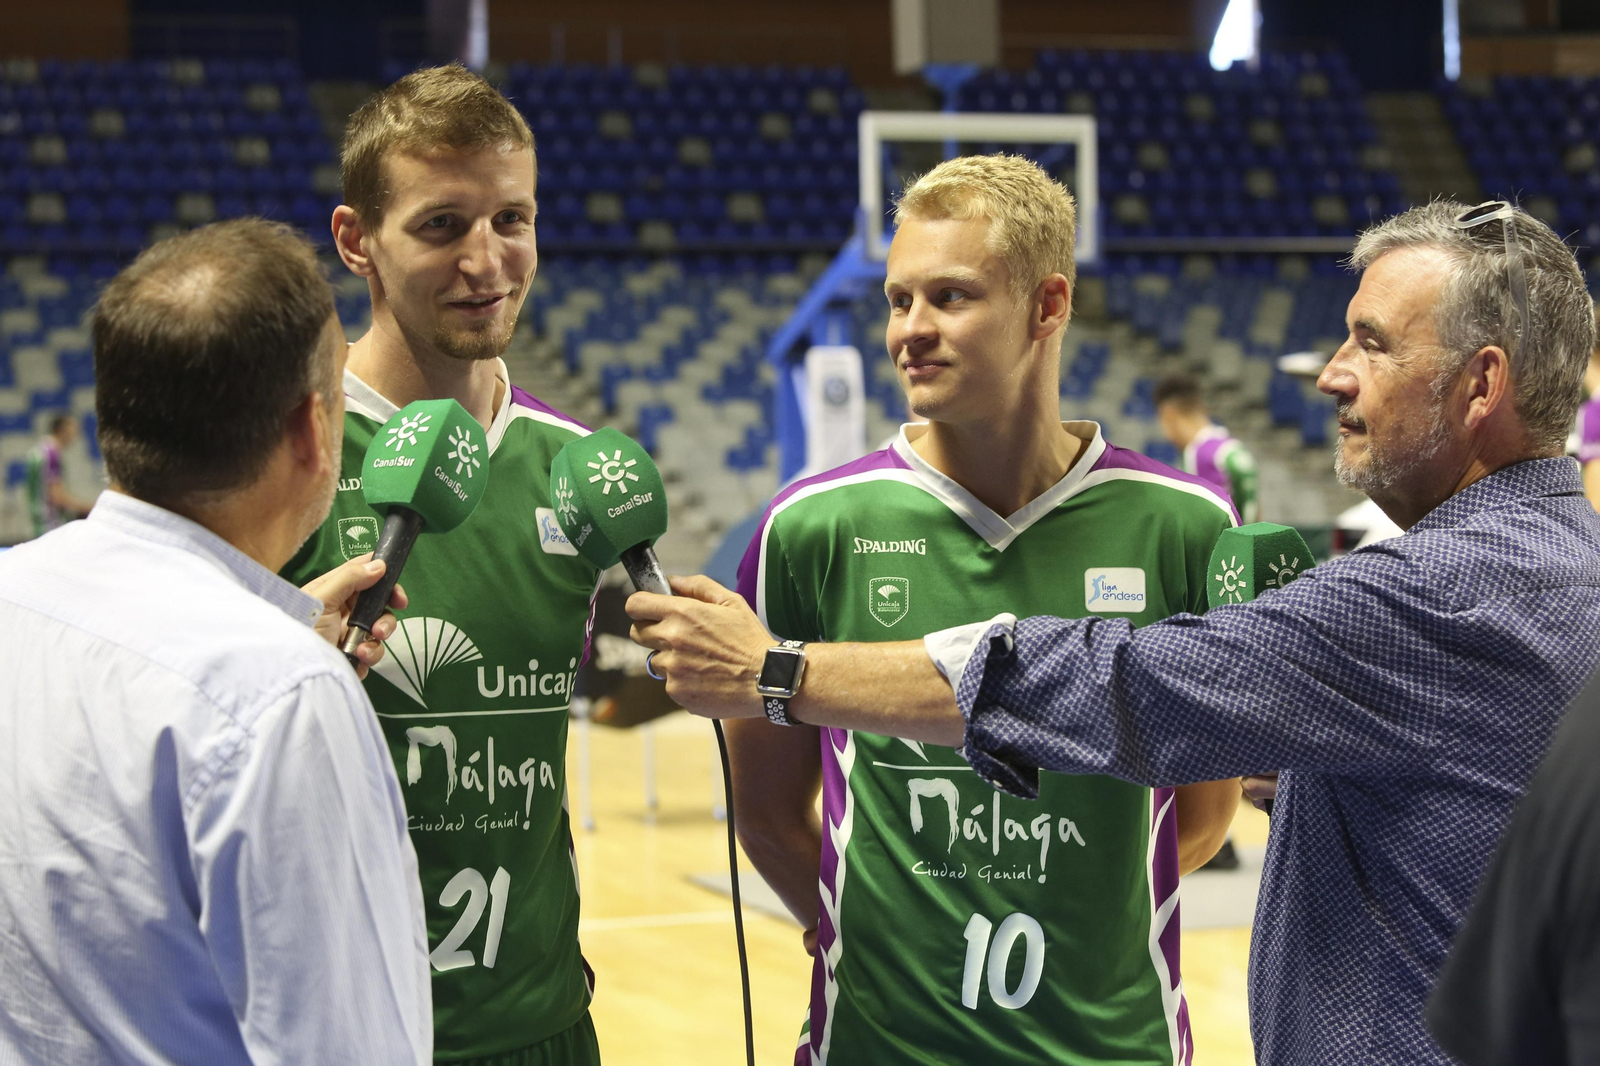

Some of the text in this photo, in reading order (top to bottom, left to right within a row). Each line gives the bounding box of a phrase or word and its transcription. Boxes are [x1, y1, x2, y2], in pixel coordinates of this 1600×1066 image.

[373, 455, 415, 468] CanalSur
[434, 466, 468, 501] CanalSur
[607, 491, 653, 518] CanalSur
[853, 536, 926, 556] SPALDING
[1101, 580, 1118, 593] liga
[1102, 591, 1144, 601] endesa
[877, 600, 900, 608] Unicaja
[405, 725, 556, 818] Málaga
[406, 813, 465, 831] Ciudad
[907, 777, 1086, 872] Málaga
[911, 860, 967, 879] Ciudad
[428, 866, 511, 972] 21
[961, 912, 1045, 1010] 10
